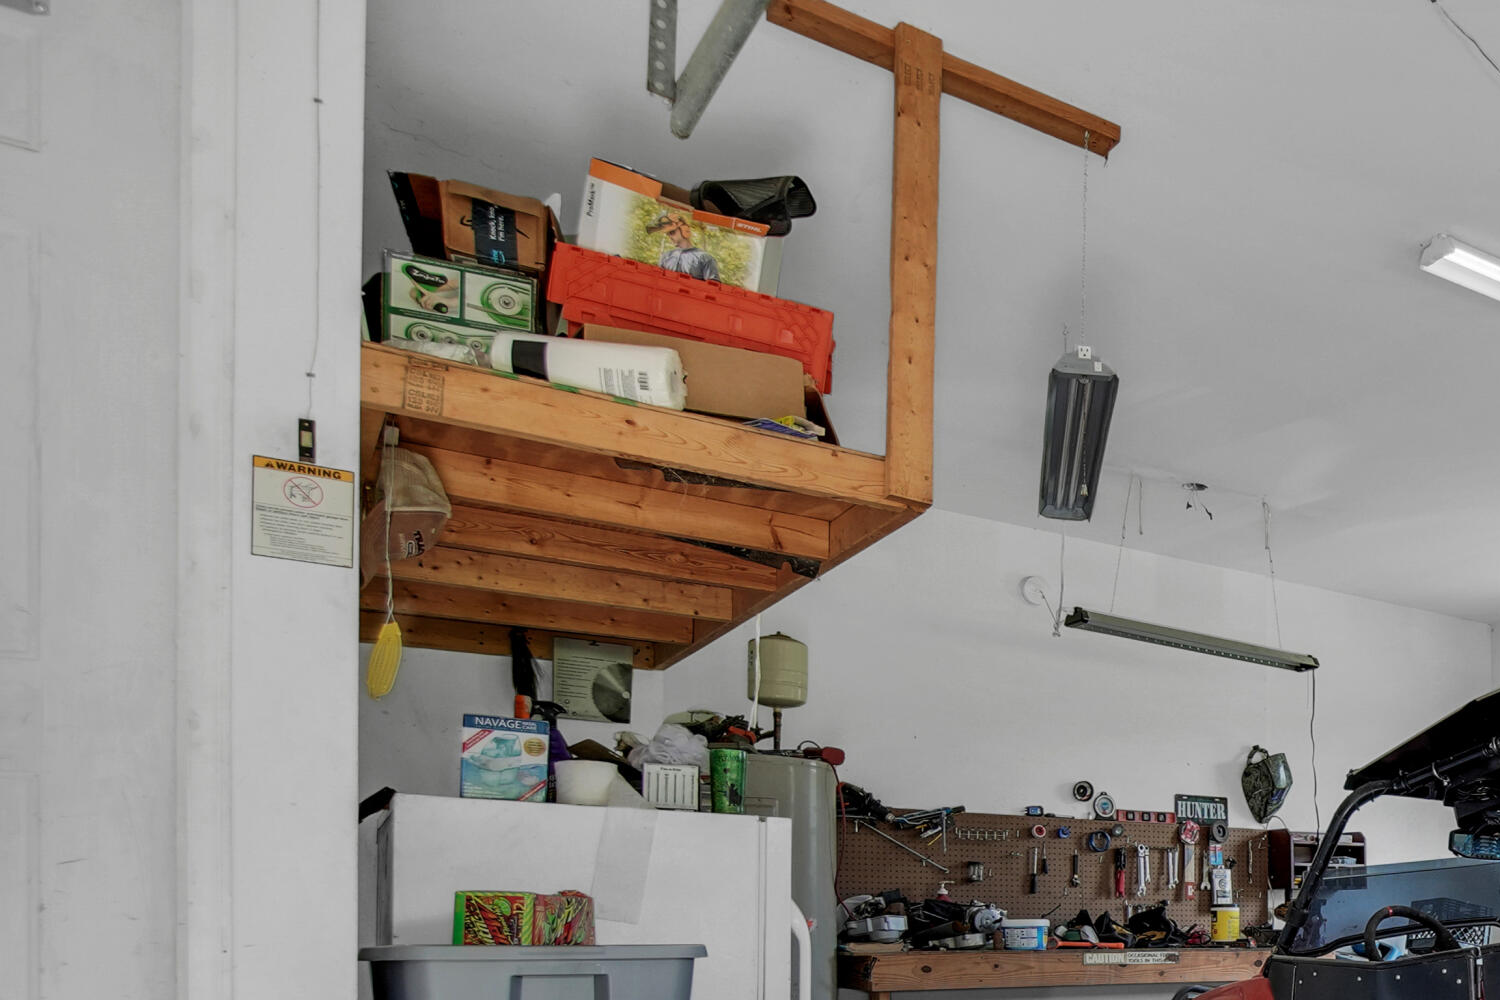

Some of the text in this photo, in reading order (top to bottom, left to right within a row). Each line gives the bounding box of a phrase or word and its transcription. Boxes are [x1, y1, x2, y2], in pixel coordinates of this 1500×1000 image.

[736, 222, 763, 234] STIHL
[275, 461, 342, 480] WARNING
[474, 716, 521, 729] NAVAGE
[1177, 800, 1227, 820] HUNTER
[1085, 952, 1125, 964] CAUTION
